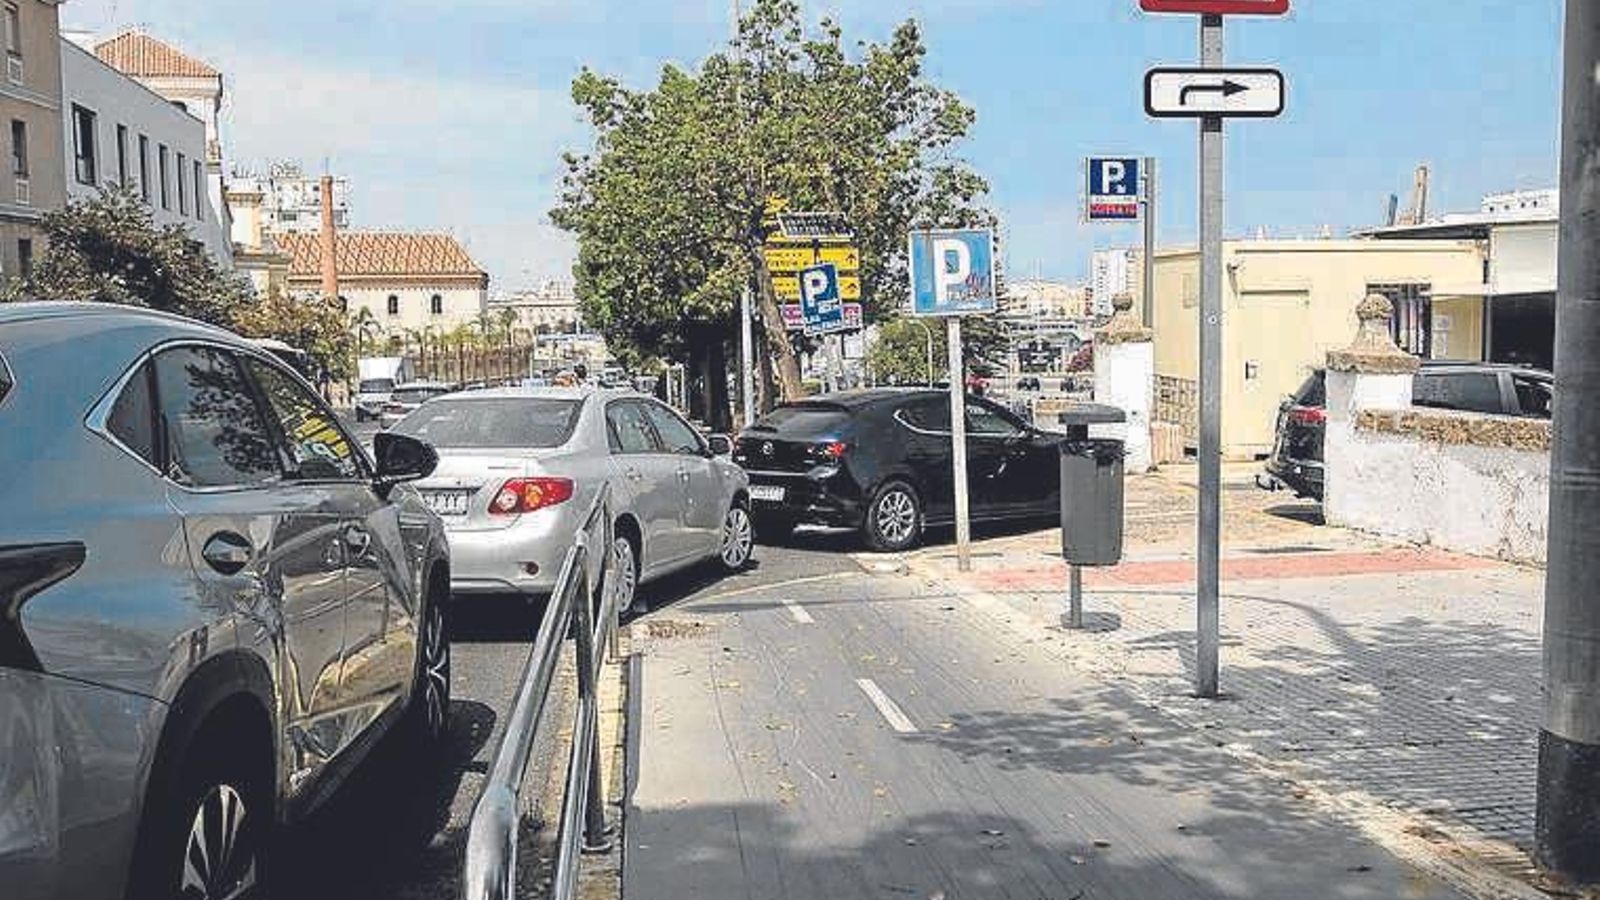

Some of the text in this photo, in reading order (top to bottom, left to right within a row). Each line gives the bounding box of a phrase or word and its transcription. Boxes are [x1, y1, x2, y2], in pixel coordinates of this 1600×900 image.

[1102, 161, 1126, 194] P
[803, 268, 829, 308] P
[934, 239, 971, 305] P
